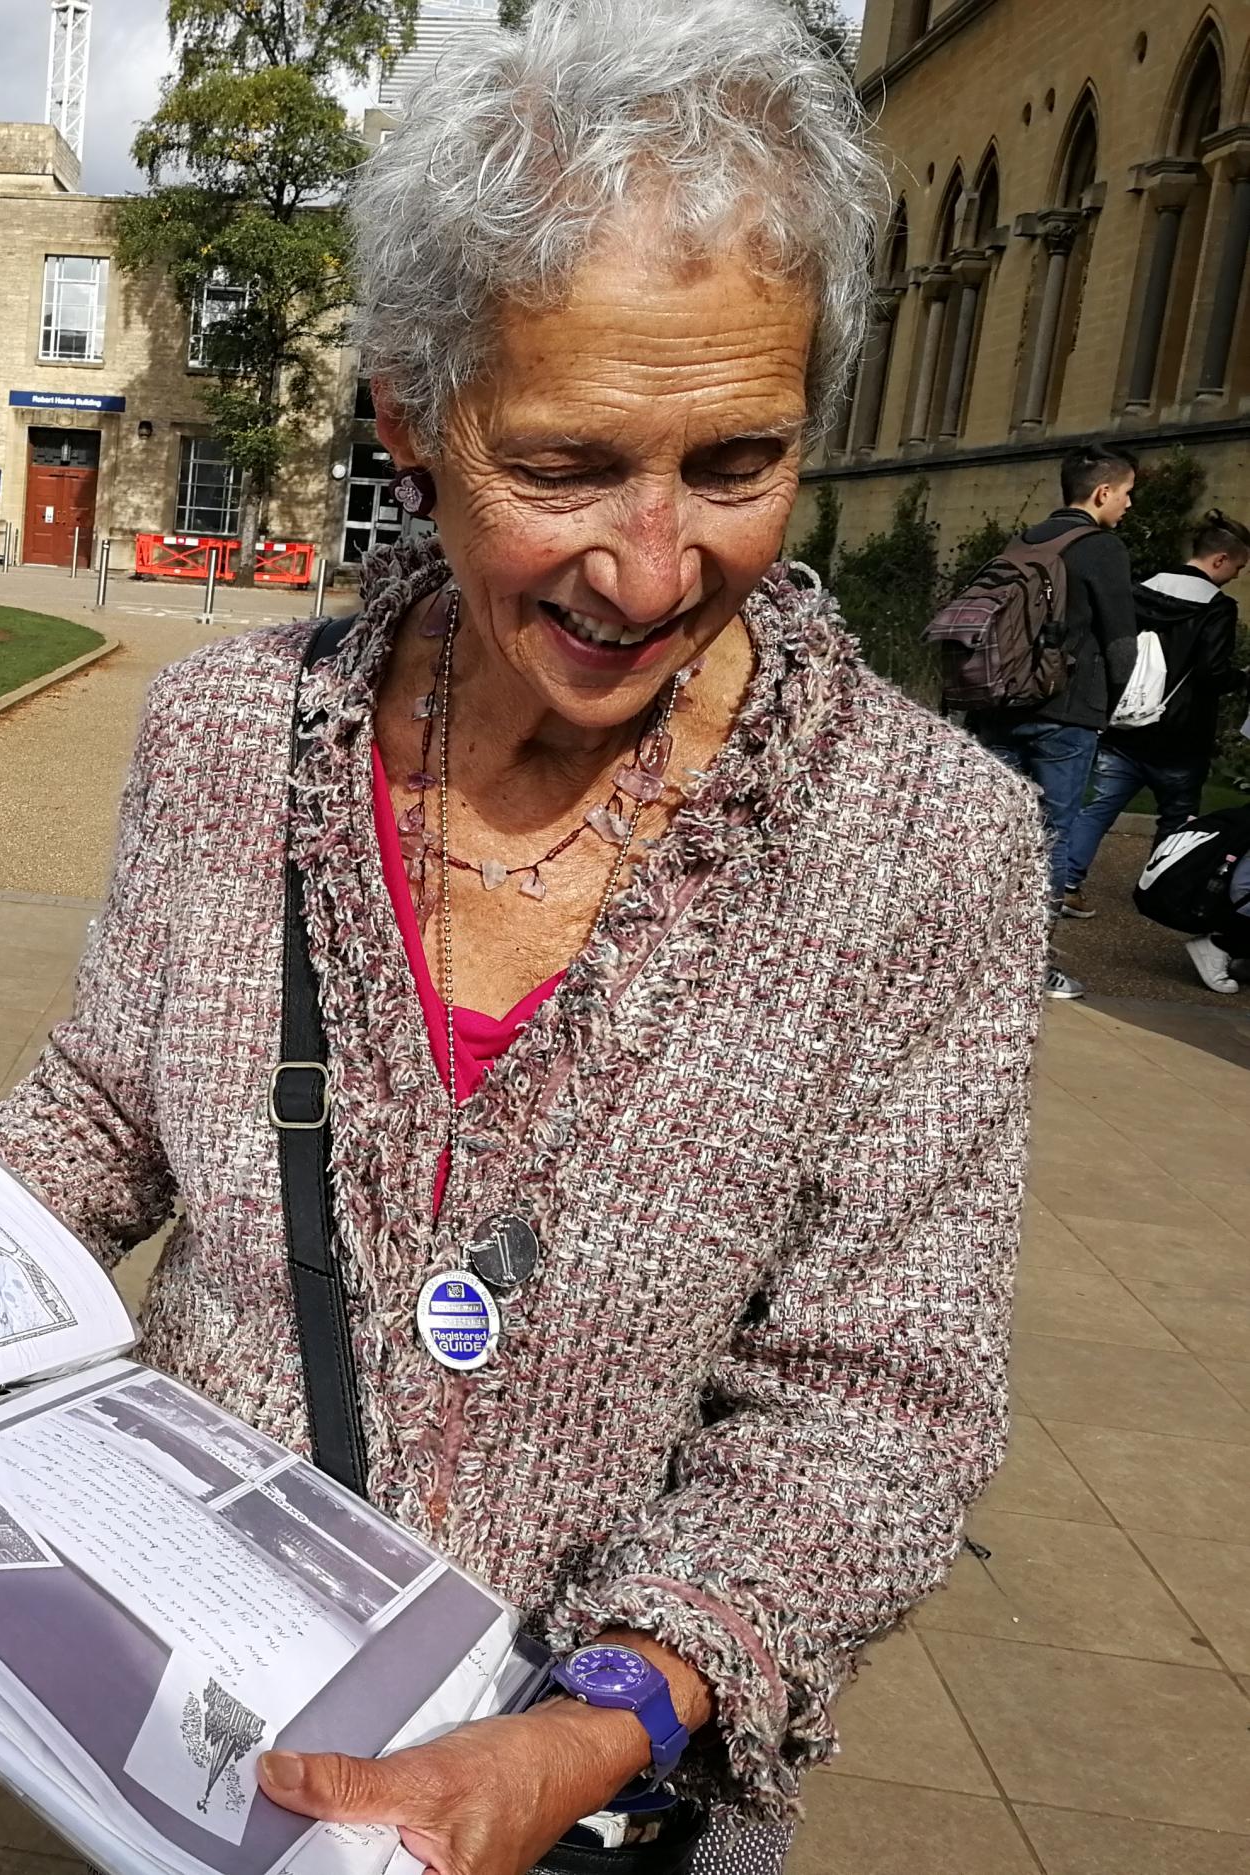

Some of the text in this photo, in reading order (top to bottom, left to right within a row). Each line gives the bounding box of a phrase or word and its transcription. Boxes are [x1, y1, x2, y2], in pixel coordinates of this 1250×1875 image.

[432, 1330, 487, 1343] Registered
[439, 1341, 483, 1353] GUIDE
[201, 1443, 256, 1487] ENGLAND
[258, 1484, 307, 1522] OXFORD
[140, 1593, 174, 1622] BIRDS
